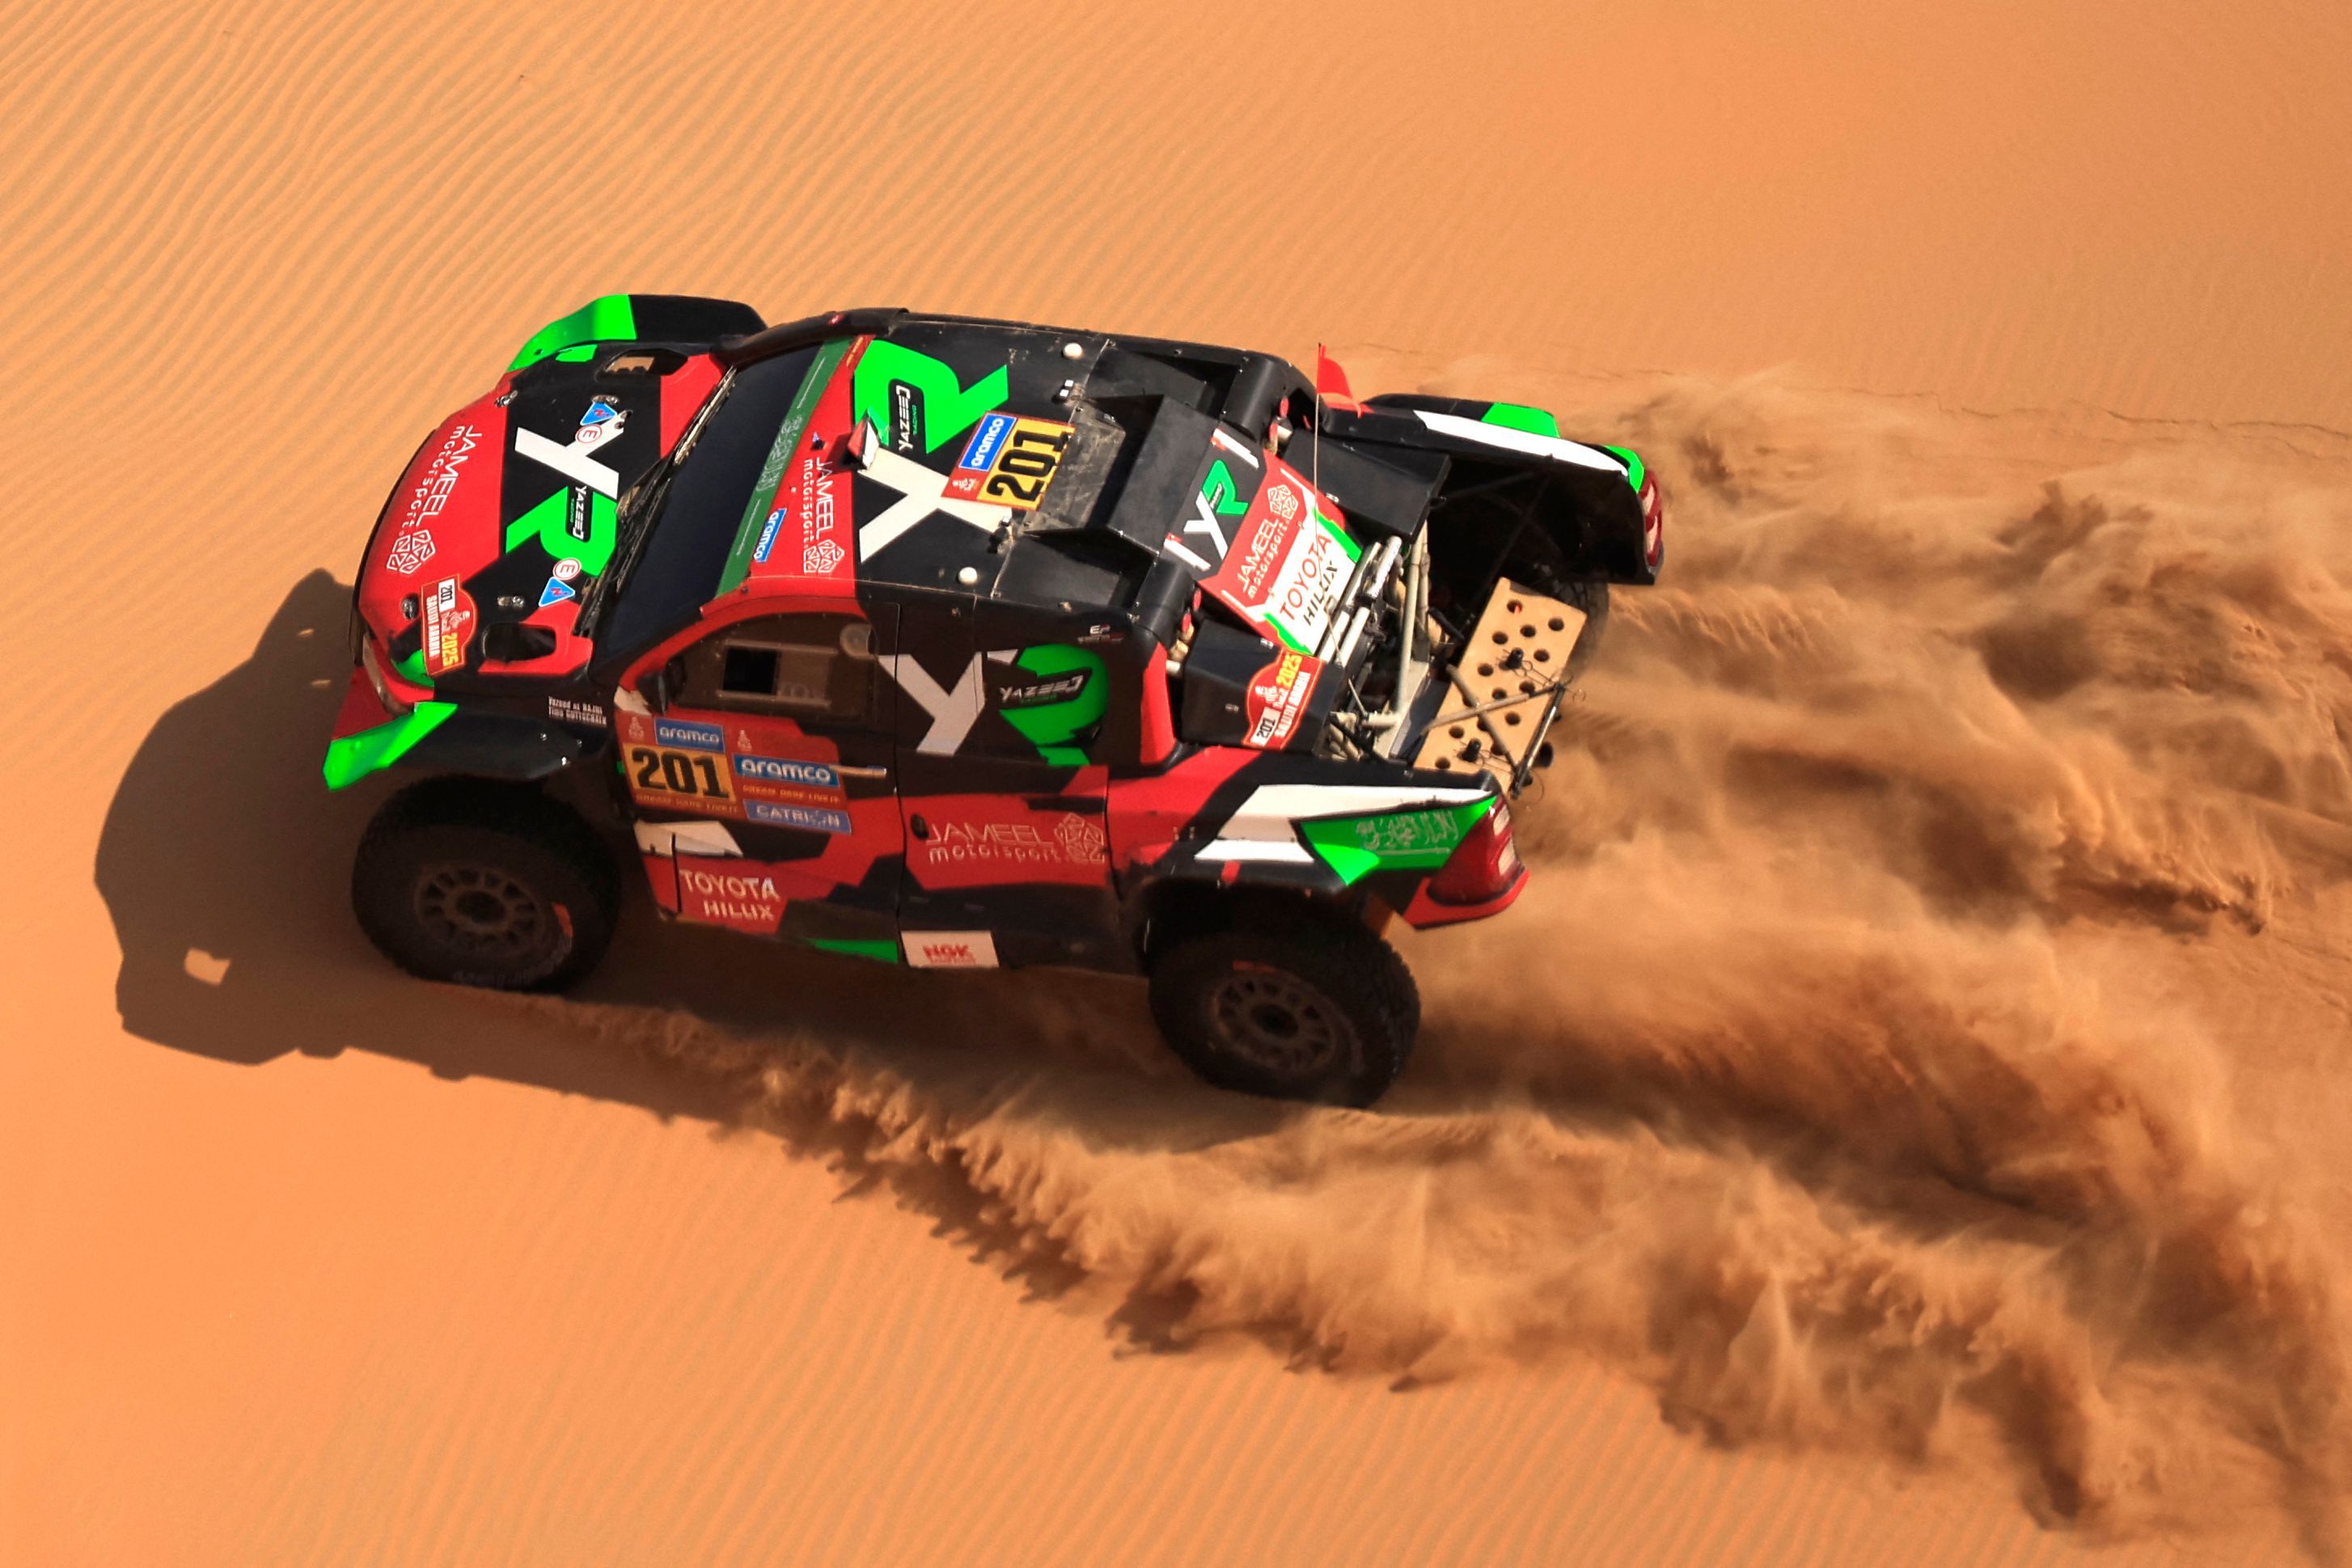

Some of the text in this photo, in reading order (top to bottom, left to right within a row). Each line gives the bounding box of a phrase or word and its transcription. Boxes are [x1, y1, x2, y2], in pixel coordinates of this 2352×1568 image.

[971, 417, 1005, 467] aramco
[987, 430, 1071, 502] 201
[401, 426, 465, 528] motorsport
[416, 425, 483, 526] JAMEEL
[816, 457, 834, 540] JAMEEL
[800, 459, 814, 544] motorsport
[753, 511, 780, 560] aramco
[1237, 518, 1279, 592] JAMEEL
[1247, 522, 1288, 598] motorsport
[440, 584, 453, 604] 201
[1280, 534, 1332, 620] TOYOTA
[1303, 560, 1338, 627] HILUX
[426, 594, 440, 657] SAUDI ARABIA
[442, 632, 459, 666] 2025
[1275, 652, 1302, 687] 2025
[1256, 717, 1276, 738] 201
[1274, 704, 1297, 738] SAUDI
[1288, 671, 1311, 706] ARABIA
[659, 726, 720, 743] aramco
[631, 746, 730, 798] 201
[741, 759, 831, 783] aramco
[926, 822, 1054, 846] JAMEEL
[929, 844, 1061, 865] motorsport
[679, 869, 781, 902] TOYOTA
[703, 899, 774, 921] HILUX
[923, 943, 969, 957] NGK
